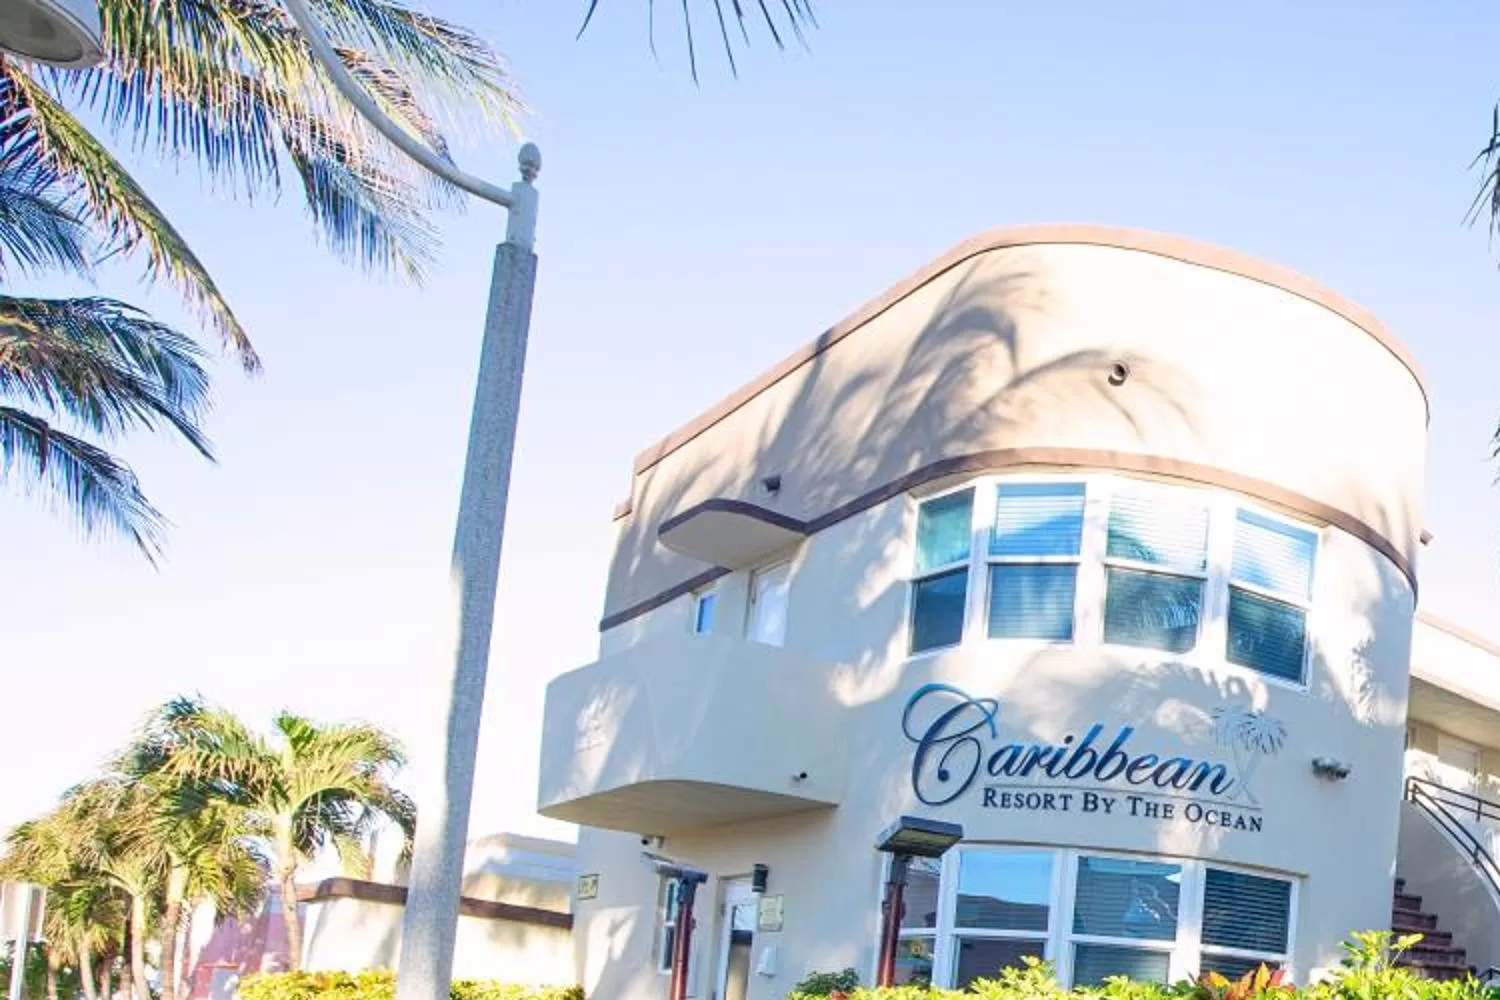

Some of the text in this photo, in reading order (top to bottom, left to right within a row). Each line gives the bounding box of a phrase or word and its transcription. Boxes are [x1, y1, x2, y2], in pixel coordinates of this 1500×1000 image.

[902, 683, 1234, 806] Caribbean
[982, 787, 1264, 833] RESORT BY THE OCEAN
